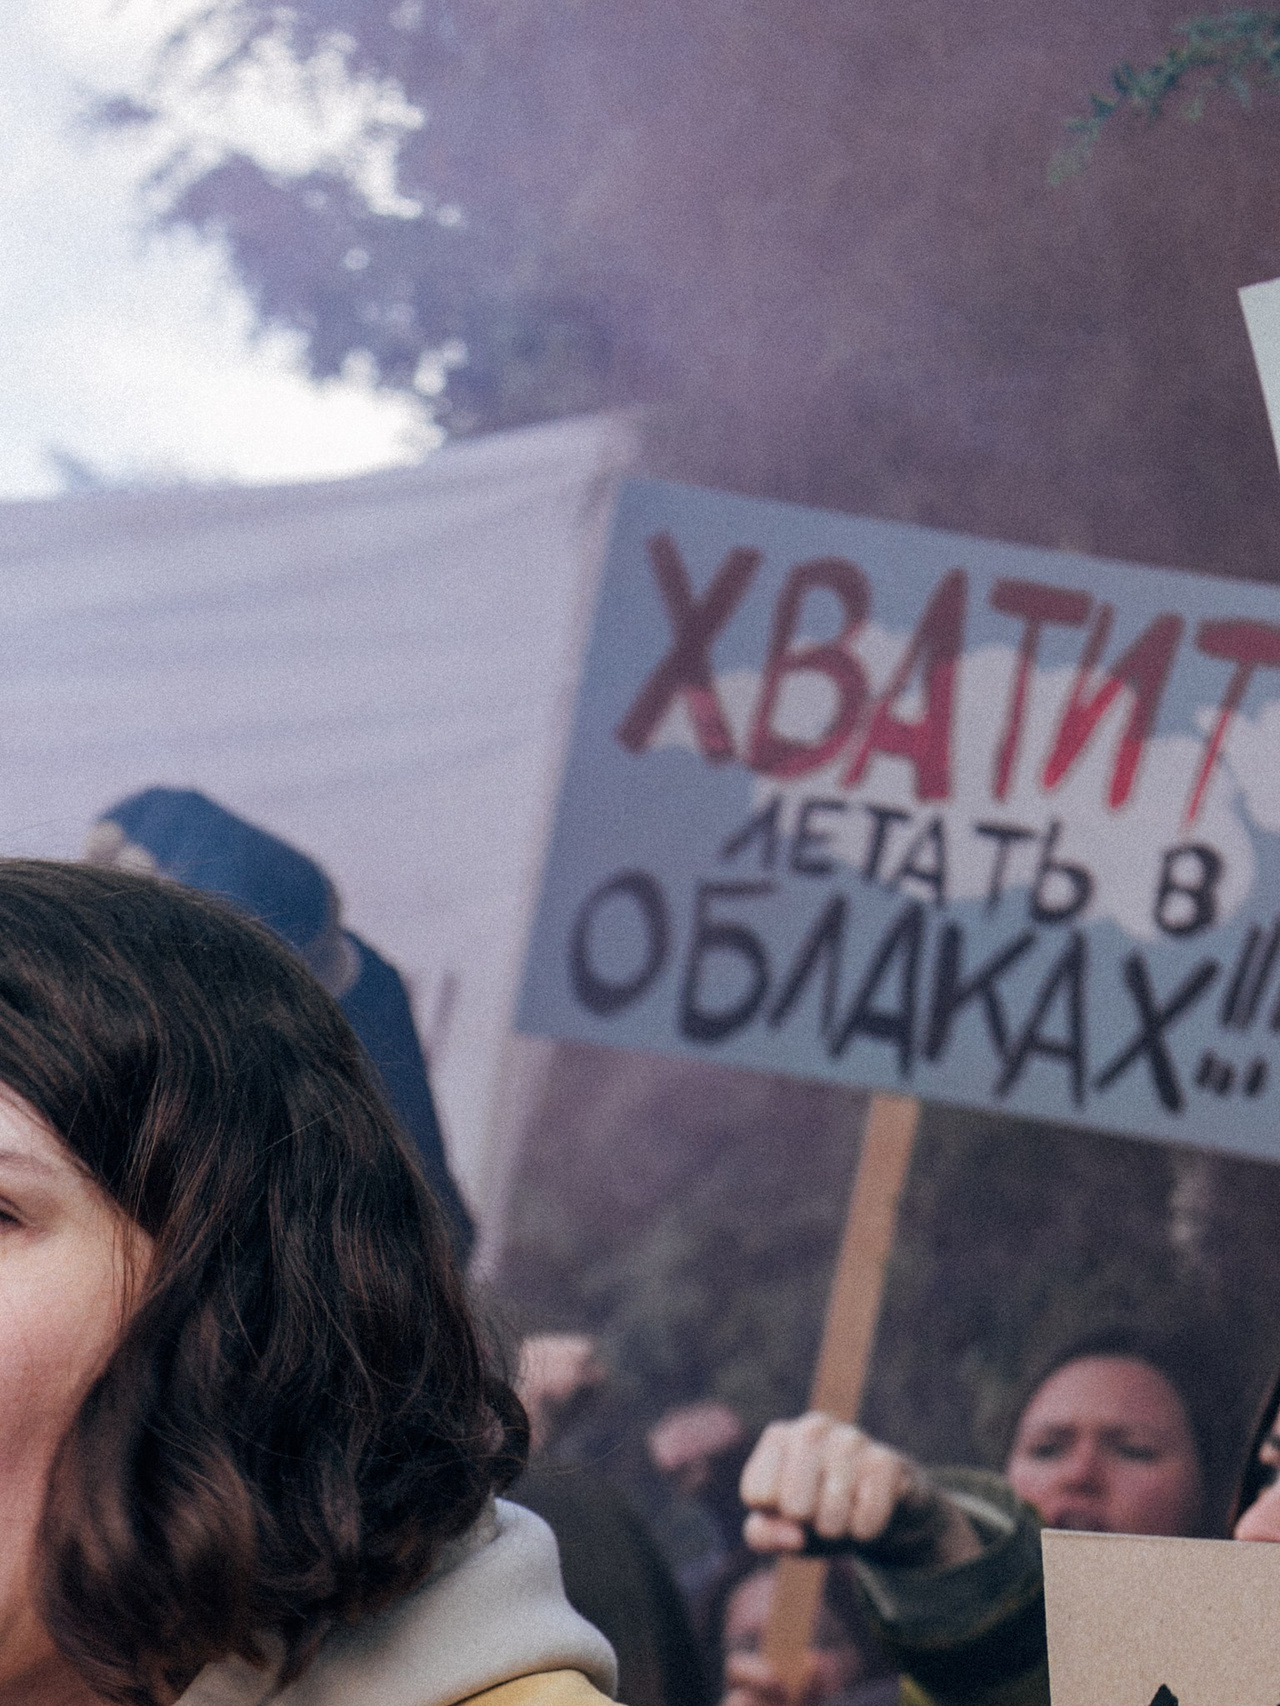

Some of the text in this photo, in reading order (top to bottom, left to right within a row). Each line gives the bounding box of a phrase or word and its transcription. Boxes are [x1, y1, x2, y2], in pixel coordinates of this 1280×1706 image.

[616, 532, 1280, 825] ХВАТИТ
[720, 795, 1224, 937] ЛЕТАТЬ В
